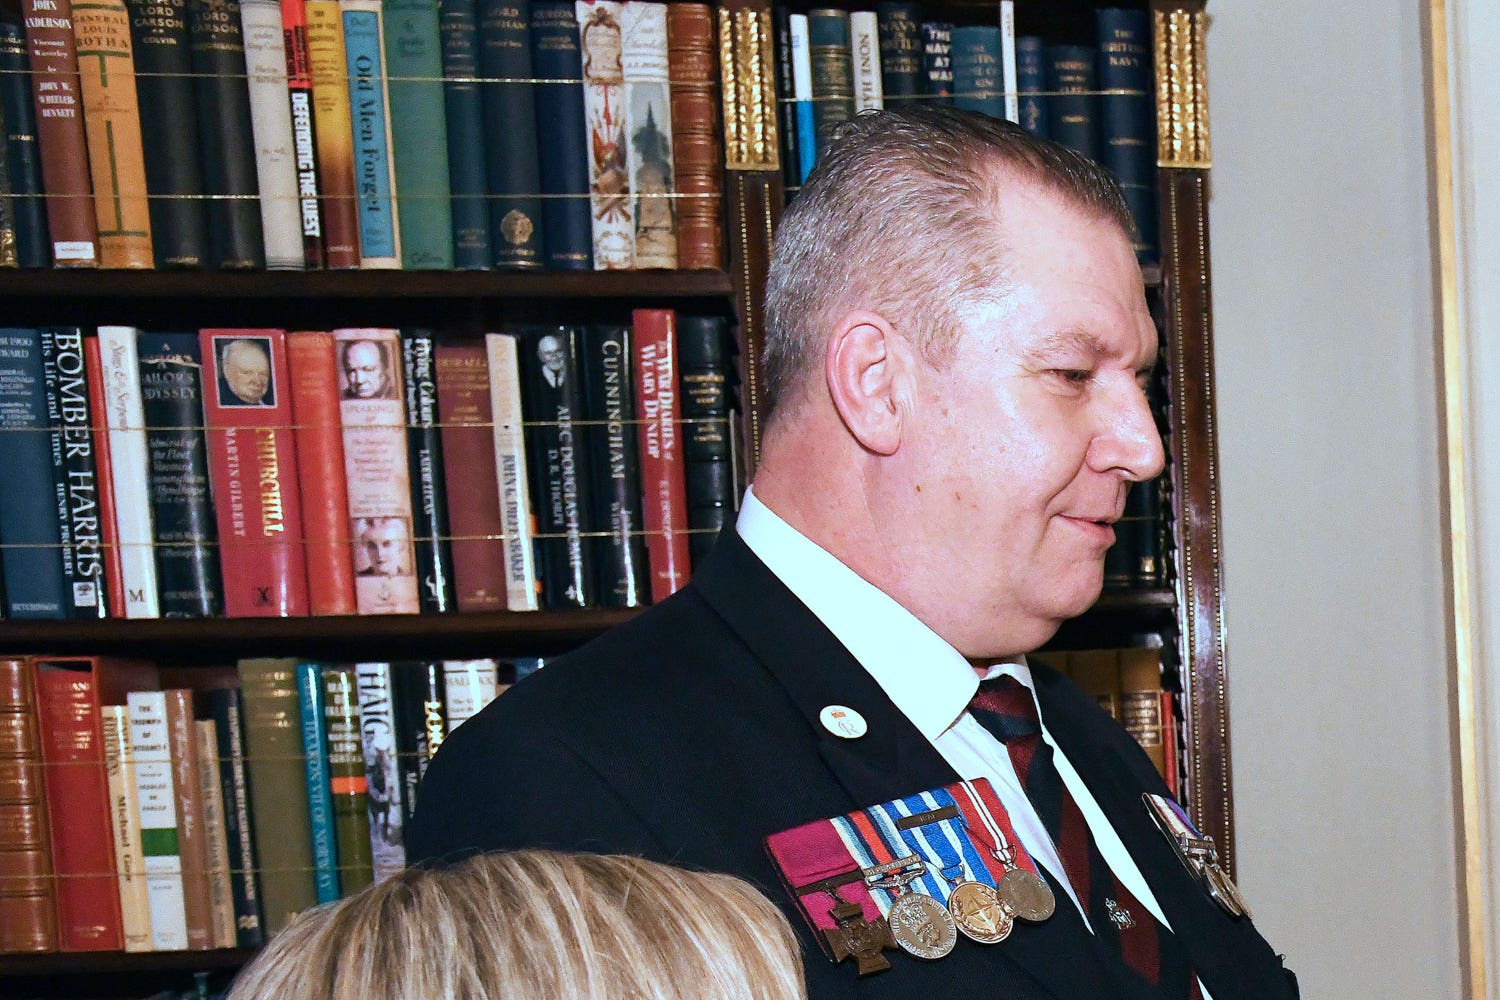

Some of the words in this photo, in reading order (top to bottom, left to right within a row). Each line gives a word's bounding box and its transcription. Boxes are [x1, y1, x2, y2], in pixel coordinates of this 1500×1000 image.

[73, 15, 127, 25] GENERAL
[77, 37, 128, 48] BOTHA
[859, 33, 872, 76] NONE
[355, 54, 374, 91] Old
[359, 99, 378, 142] Men
[299, 171, 317, 198] THE
[362, 148, 381, 213] Forget
[301, 198, 321, 238] WEST
[41, 333, 53, 357] His
[44, 361, 57, 388] Life
[54, 328, 90, 458] BOMBER
[47, 392, 60, 419] and
[602, 340, 625, 479] CUNNINGHAM
[658, 391, 675, 449] DIARIES
[50, 424, 63, 467] Times
[644, 398, 660, 459] DUNLOP
[225, 427, 240, 477] MARTIN
[255, 427, 284, 537] CHURCHILL
[67, 470, 102, 577] HARRIS
[231, 480, 246, 537] GILBERT
[129, 589, 145, 603] M
[361, 672, 392, 736] HAIG
